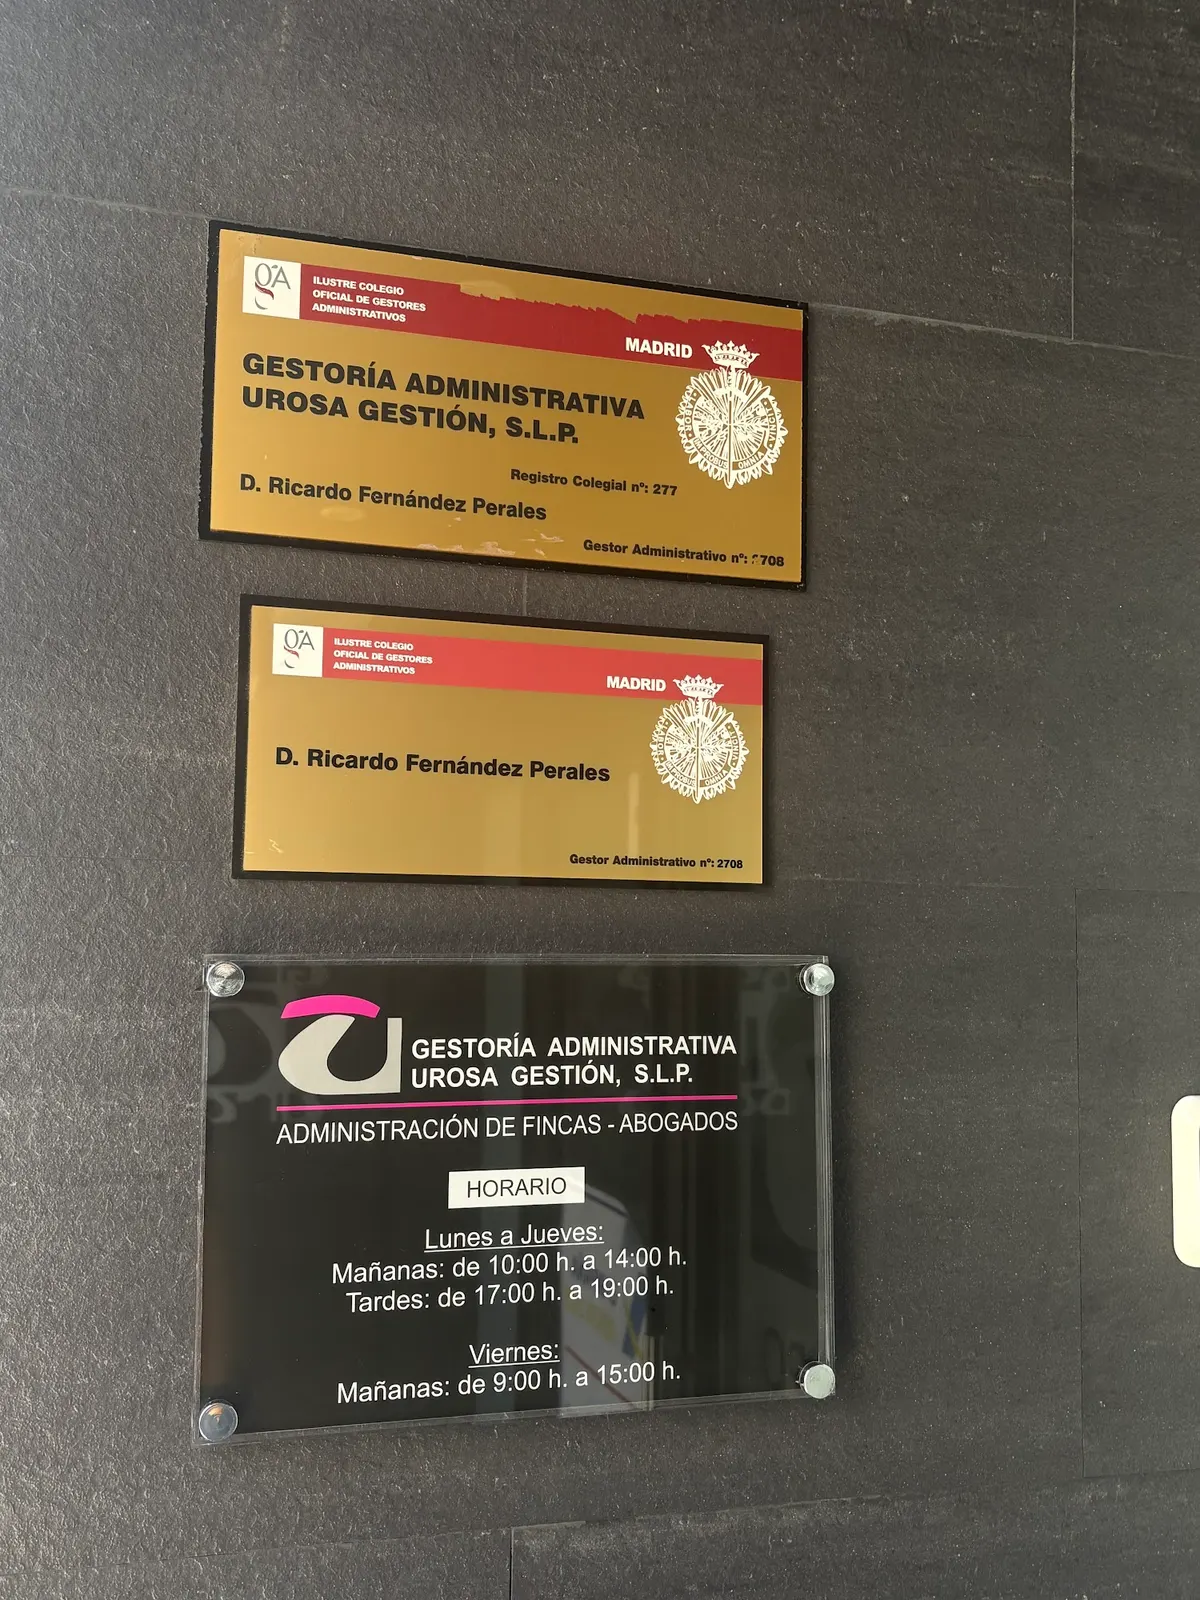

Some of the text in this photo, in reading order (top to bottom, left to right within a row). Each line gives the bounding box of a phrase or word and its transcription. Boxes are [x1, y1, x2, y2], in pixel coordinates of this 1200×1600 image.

[313, 276, 404, 295] ILUSTRE COLEGIO
[312, 303, 406, 322] ADMINISTRATIVOS
[313, 290, 426, 312] OFICIAL DE GESTORES
[626, 337, 692, 358] MADRID
[243, 353, 645, 419] GESTORÍA ADMINISTRATIVA
[243, 386, 578, 443] UROSA GESTIÓN, S.L.P.
[738, 452, 764, 469] OMNIA
[511, 469, 567, 485] Registro
[573, 476, 626, 491] Colegial
[653, 484, 677, 495] 277
[241, 474, 546, 520] D. Ricardo Fernández Perales
[584, 540, 628, 553] Gestor
[632, 544, 726, 562] Administrativo
[334, 638, 413, 650] ILUSTRE COLEGIO
[333, 662, 415, 674] ADMINISTRATIVOS
[334, 650, 369, 659] OFICIAL
[386, 654, 432, 664] GESTORES
[607, 676, 666, 691] MADRID
[276, 747, 610, 781] D. Ricardo Fernández Perales
[570, 854, 609, 864] Gestor
[613, 856, 695, 867] Administrativo
[717, 859, 742, 868] 2708
[412, 1033, 736, 1059] GESTORÍA ADMINISTRATIVA
[412, 1060, 692, 1088] UROSA GESTIÓN, S.L.P.
[276, 1114, 477, 1144] ADMINISTRACIÓN
[487, 1117, 515, 1137] DE
[524, 1115, 601, 1135] FINCAS
[619, 1111, 737, 1133] ABOGADOS
[468, 1177, 566, 1198] HORARIO
[425, 1224, 604, 1252] Lunes a Jueves:
[332, 1246, 686, 1283] Mañanas: de 10:00 h. a 14:00 h.
[346, 1275, 673, 1312] Tardes: de 17:00 h. a 19:00 h.
[468, 1343, 560, 1368] Viernes:
[338, 1361, 680, 1403] Mañanas: de 9:00 h. a 15:00 h.
